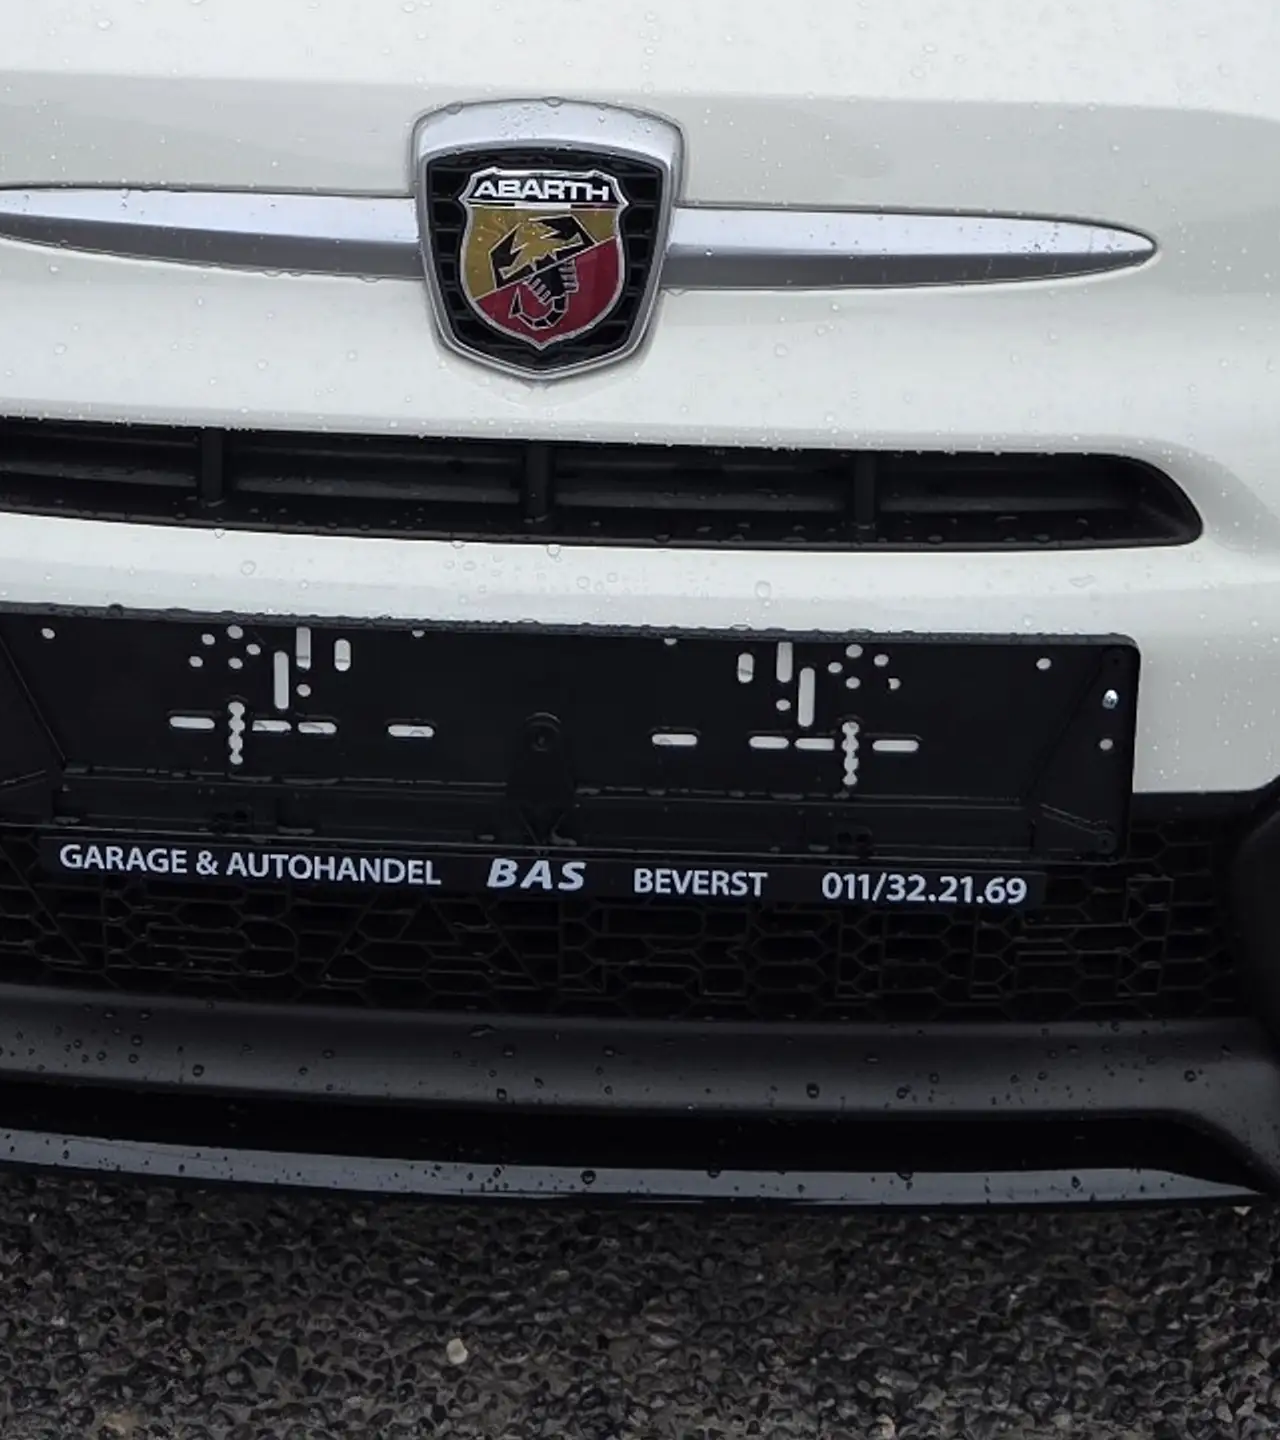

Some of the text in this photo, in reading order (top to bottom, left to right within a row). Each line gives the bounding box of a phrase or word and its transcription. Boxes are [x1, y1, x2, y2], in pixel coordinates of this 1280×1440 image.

[473, 179, 610, 202] ABARTH
[59, 843, 1029, 906] GARAGE & AUTOHANDEL BAS BEVERST 011/32.21.69
